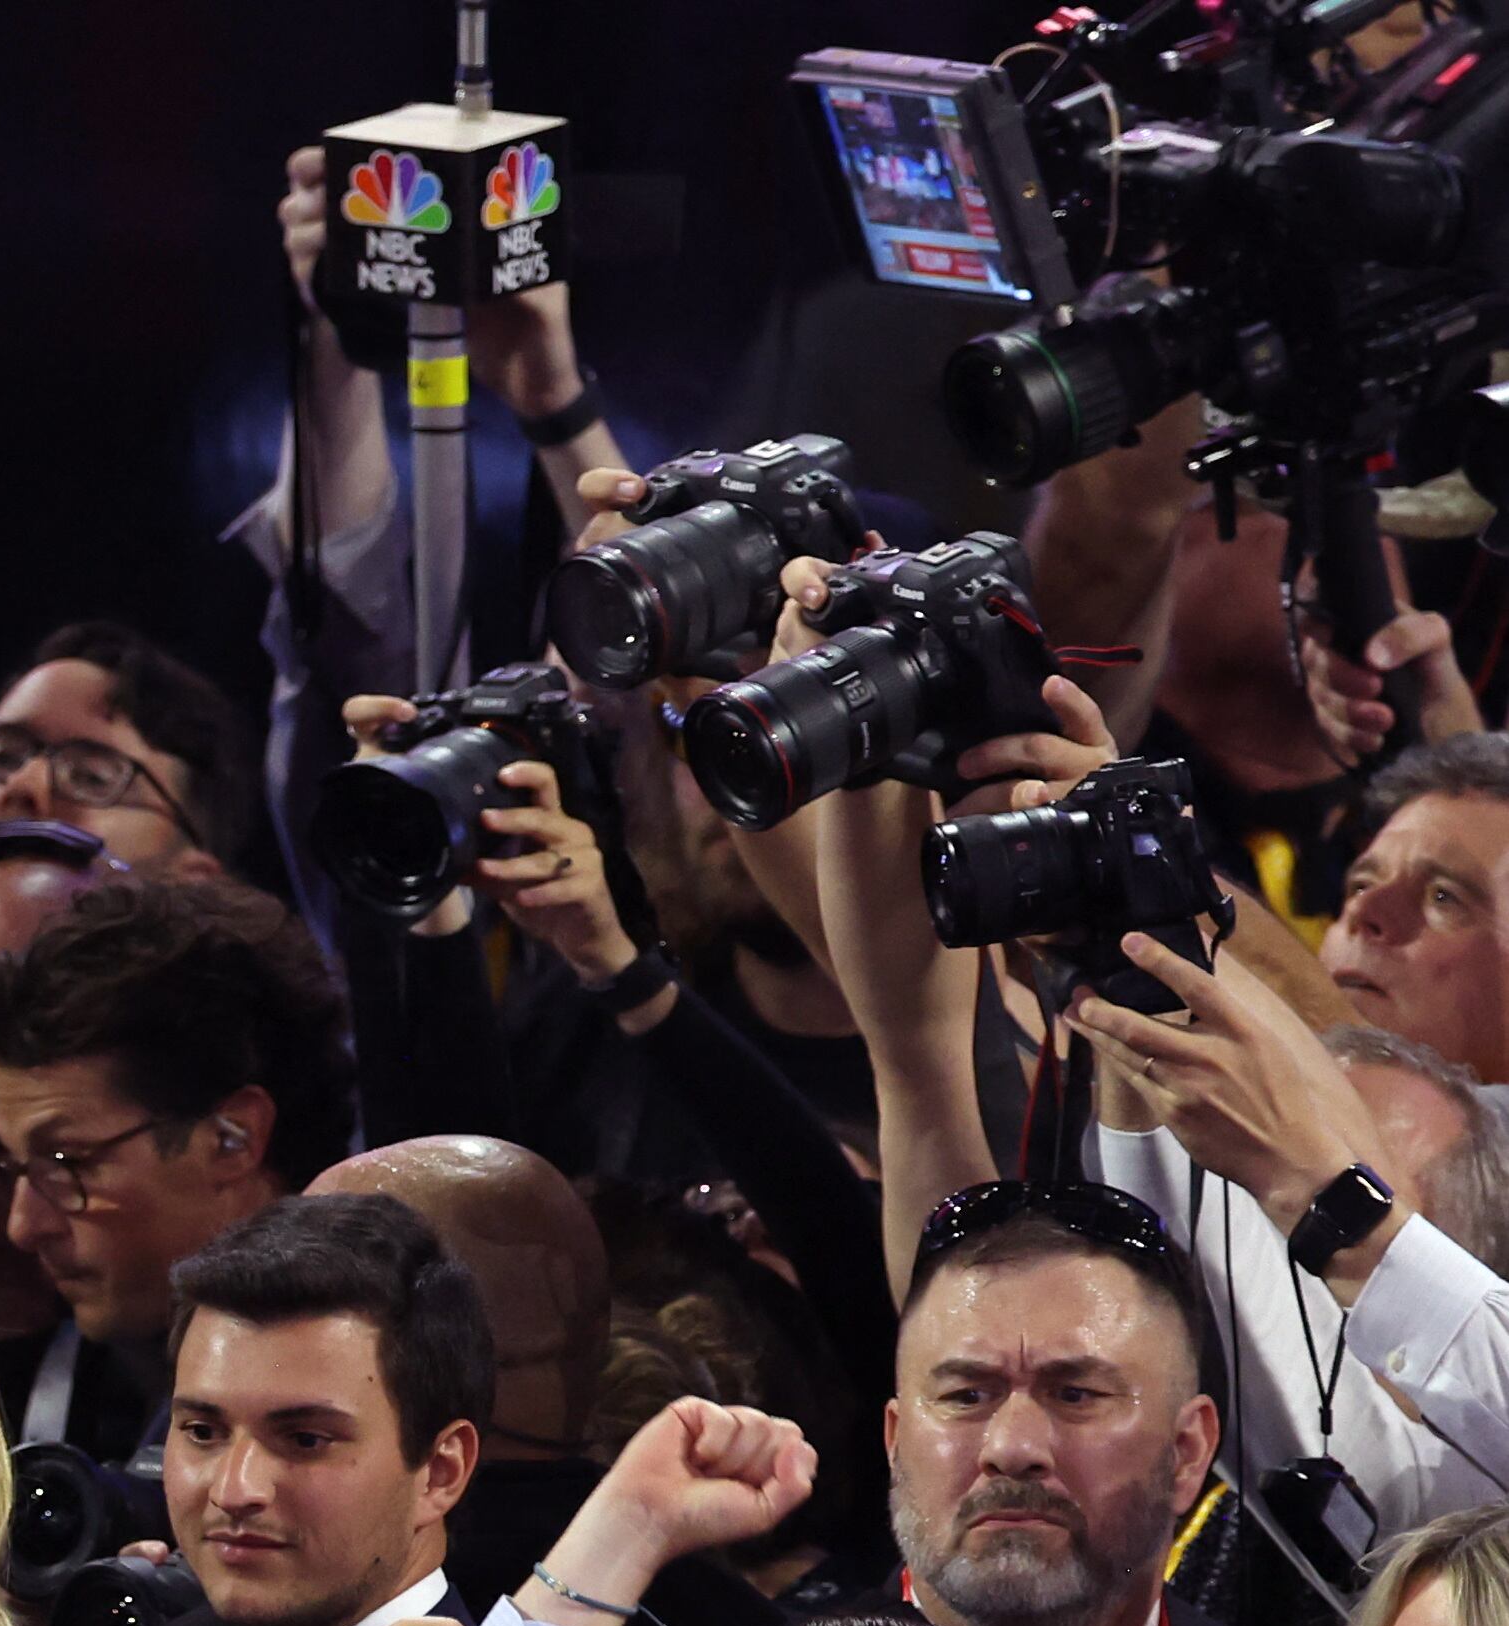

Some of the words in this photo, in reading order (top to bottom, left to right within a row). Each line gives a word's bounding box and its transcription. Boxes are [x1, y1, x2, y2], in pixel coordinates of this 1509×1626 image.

[365, 229, 427, 267] NBC
[498, 219, 544, 261] NBC
[357, 260, 437, 299] NEWS
[491, 250, 550, 295] NEWS
